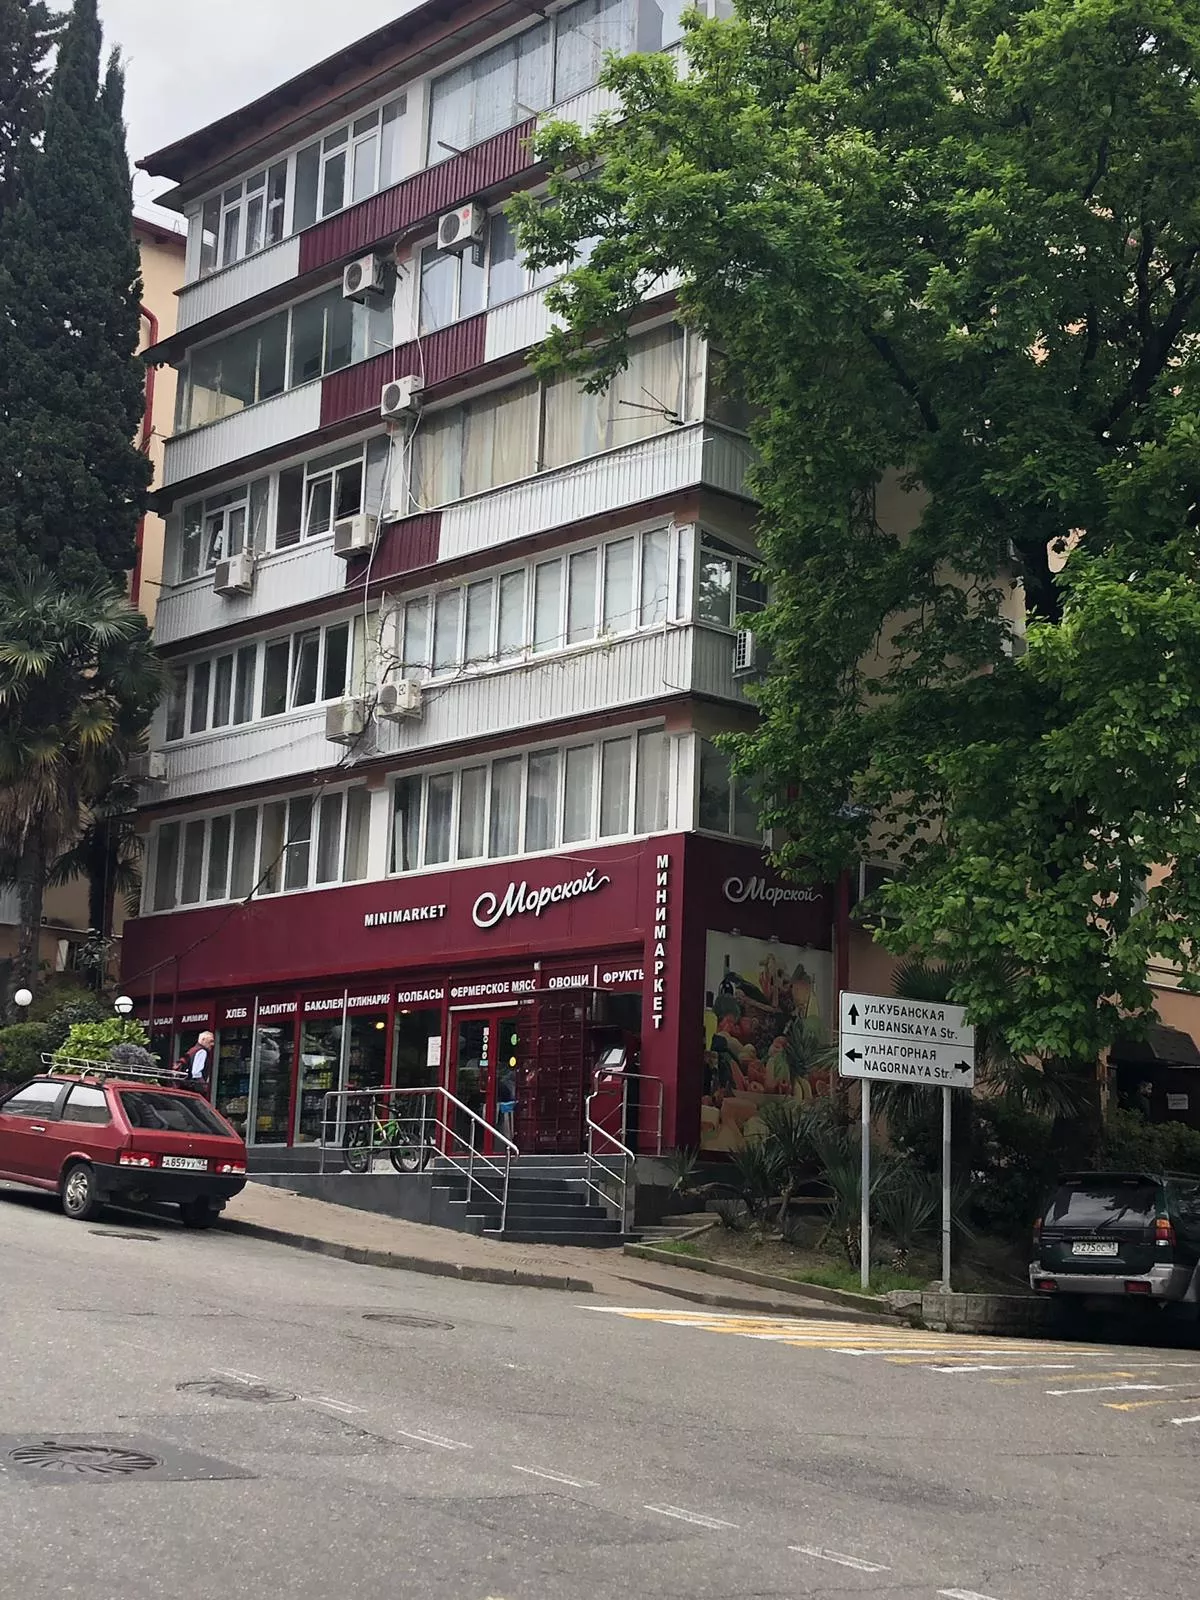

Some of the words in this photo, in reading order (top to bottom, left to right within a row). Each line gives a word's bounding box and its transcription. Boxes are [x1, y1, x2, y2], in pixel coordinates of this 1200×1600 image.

[472, 868, 610, 928] Морской
[724, 876, 823, 907] Морской
[364, 904, 447, 927] MINIMARKET
[652, 854, 669, 1029] МИНИМАРКЕТ
[450, 982, 509, 998] ФЕРМЕРСКОЕ
[549, 974, 589, 988] ОВОЩИ
[398, 988, 444, 1003] КОЛБАСЫ
[225, 1008, 247, 1019] ХЛЕБ
[259, 1001, 298, 1015] НАПИТКИ
[304, 998, 343, 1012] БАКАЛЕЯ
[864, 1003, 945, 1021] ул.КУБАНСКАЯ
[864, 1019, 937, 1037] KUBANSKAYA
[940, 1027, 958, 1040] Str.
[864, 1043, 937, 1061] ул.НАГОРНАЯ
[863, 1060, 931, 1077] NAGORNAYA
[934, 1067, 952, 1080] Str.
